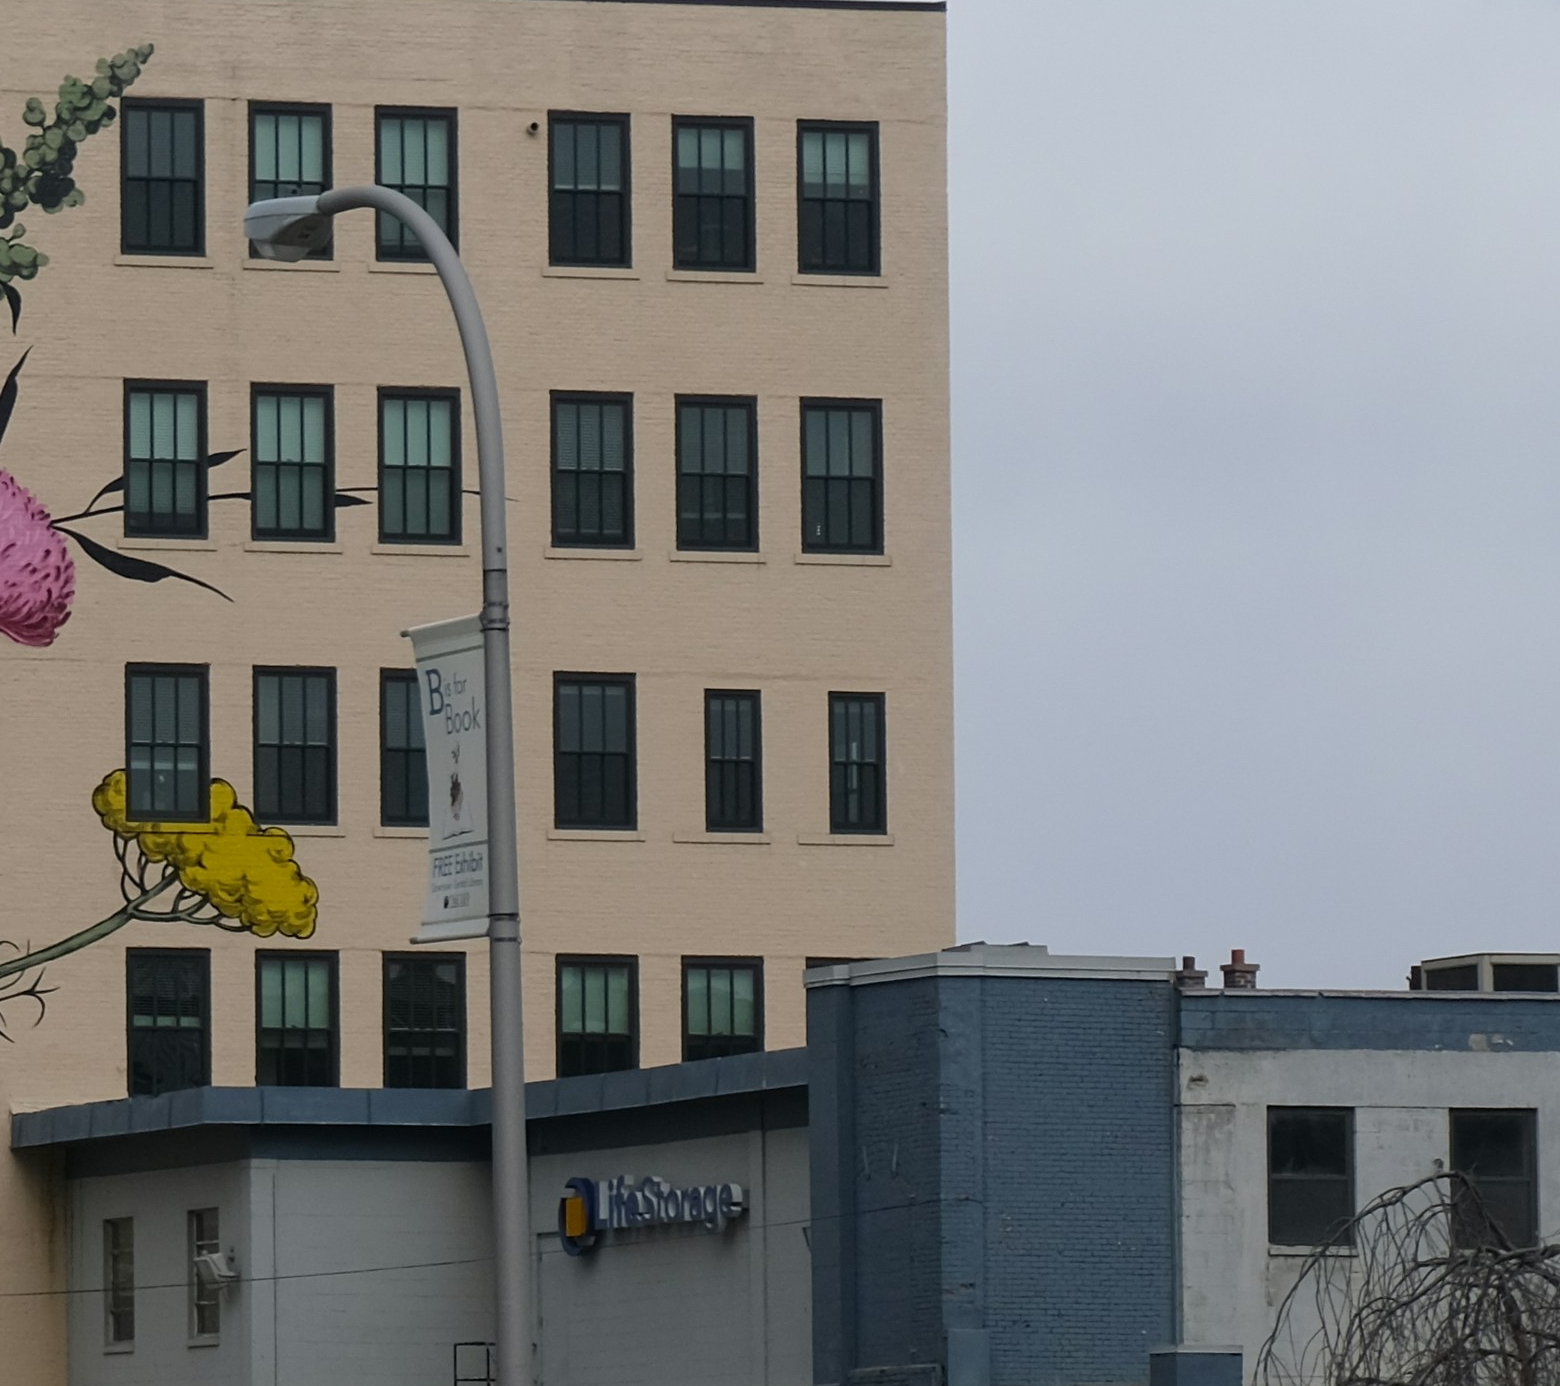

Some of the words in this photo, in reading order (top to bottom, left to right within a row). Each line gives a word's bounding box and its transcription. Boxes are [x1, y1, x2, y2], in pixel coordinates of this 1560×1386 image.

[445, 696, 481, 734] Book
[433, 855, 452, 878] FREE
[455, 850, 483, 874] Exhibit
